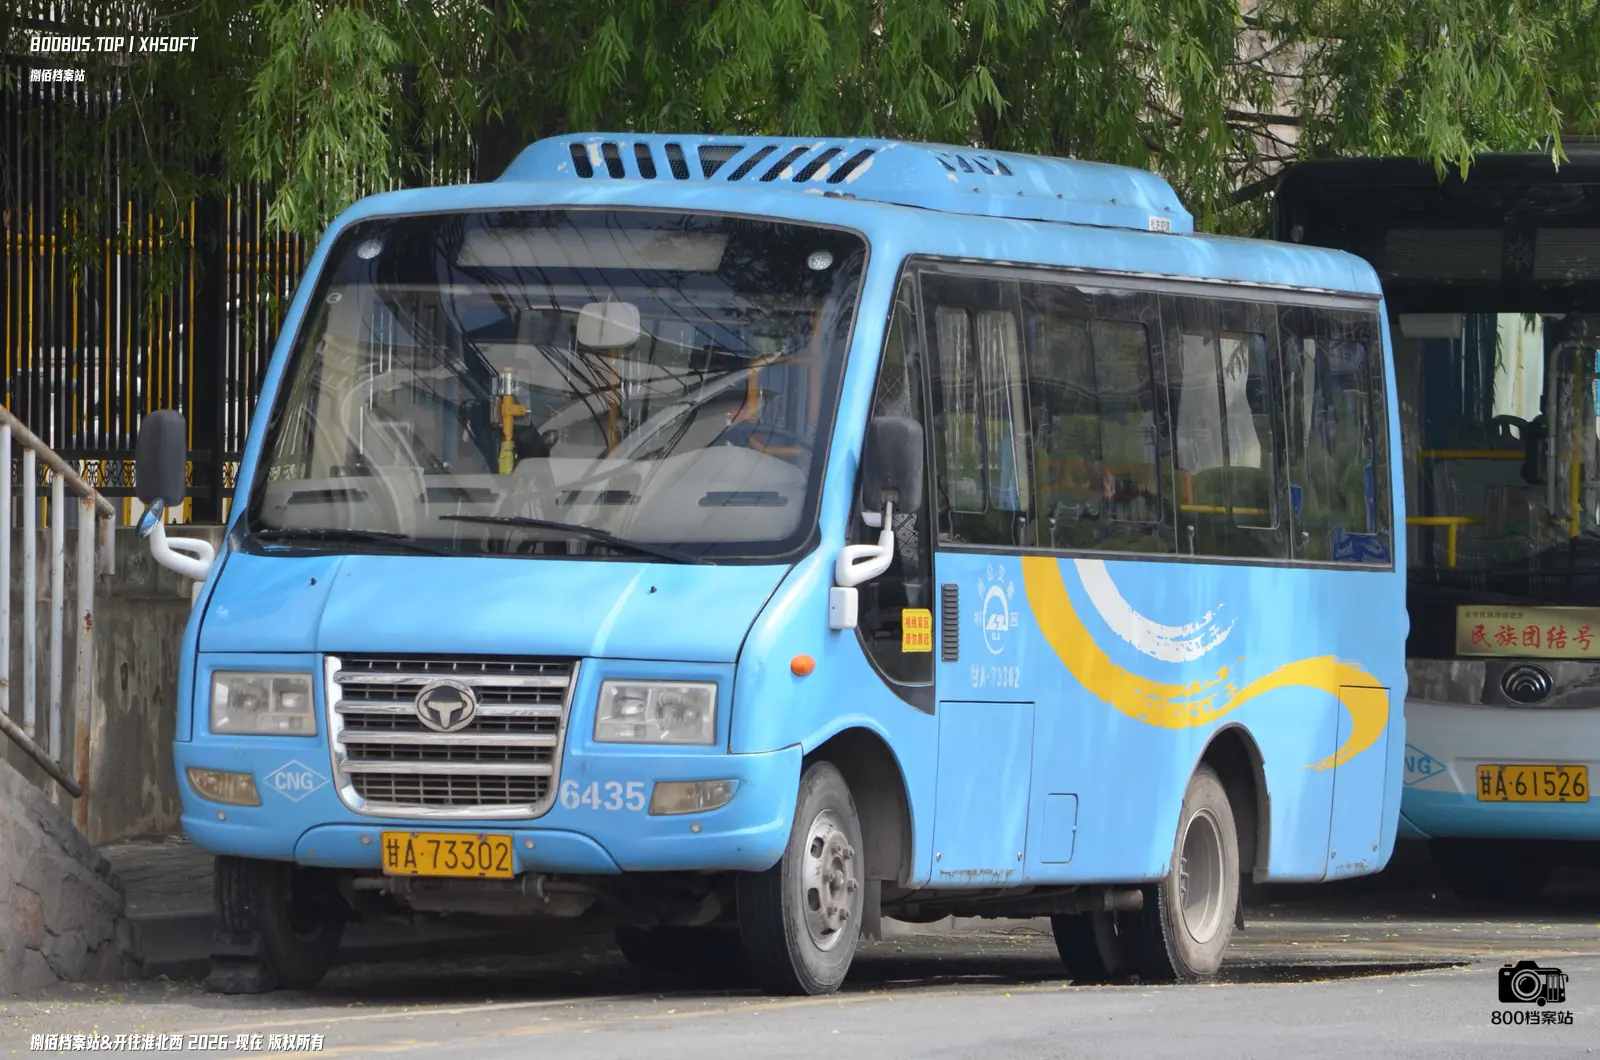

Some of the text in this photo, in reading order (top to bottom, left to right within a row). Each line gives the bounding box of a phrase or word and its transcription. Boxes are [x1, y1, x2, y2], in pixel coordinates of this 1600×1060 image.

[1470, 623, 1595, 651] 民族团结号
[274, 771, 314, 791] CNG
[560, 780, 647, 812] 6435
